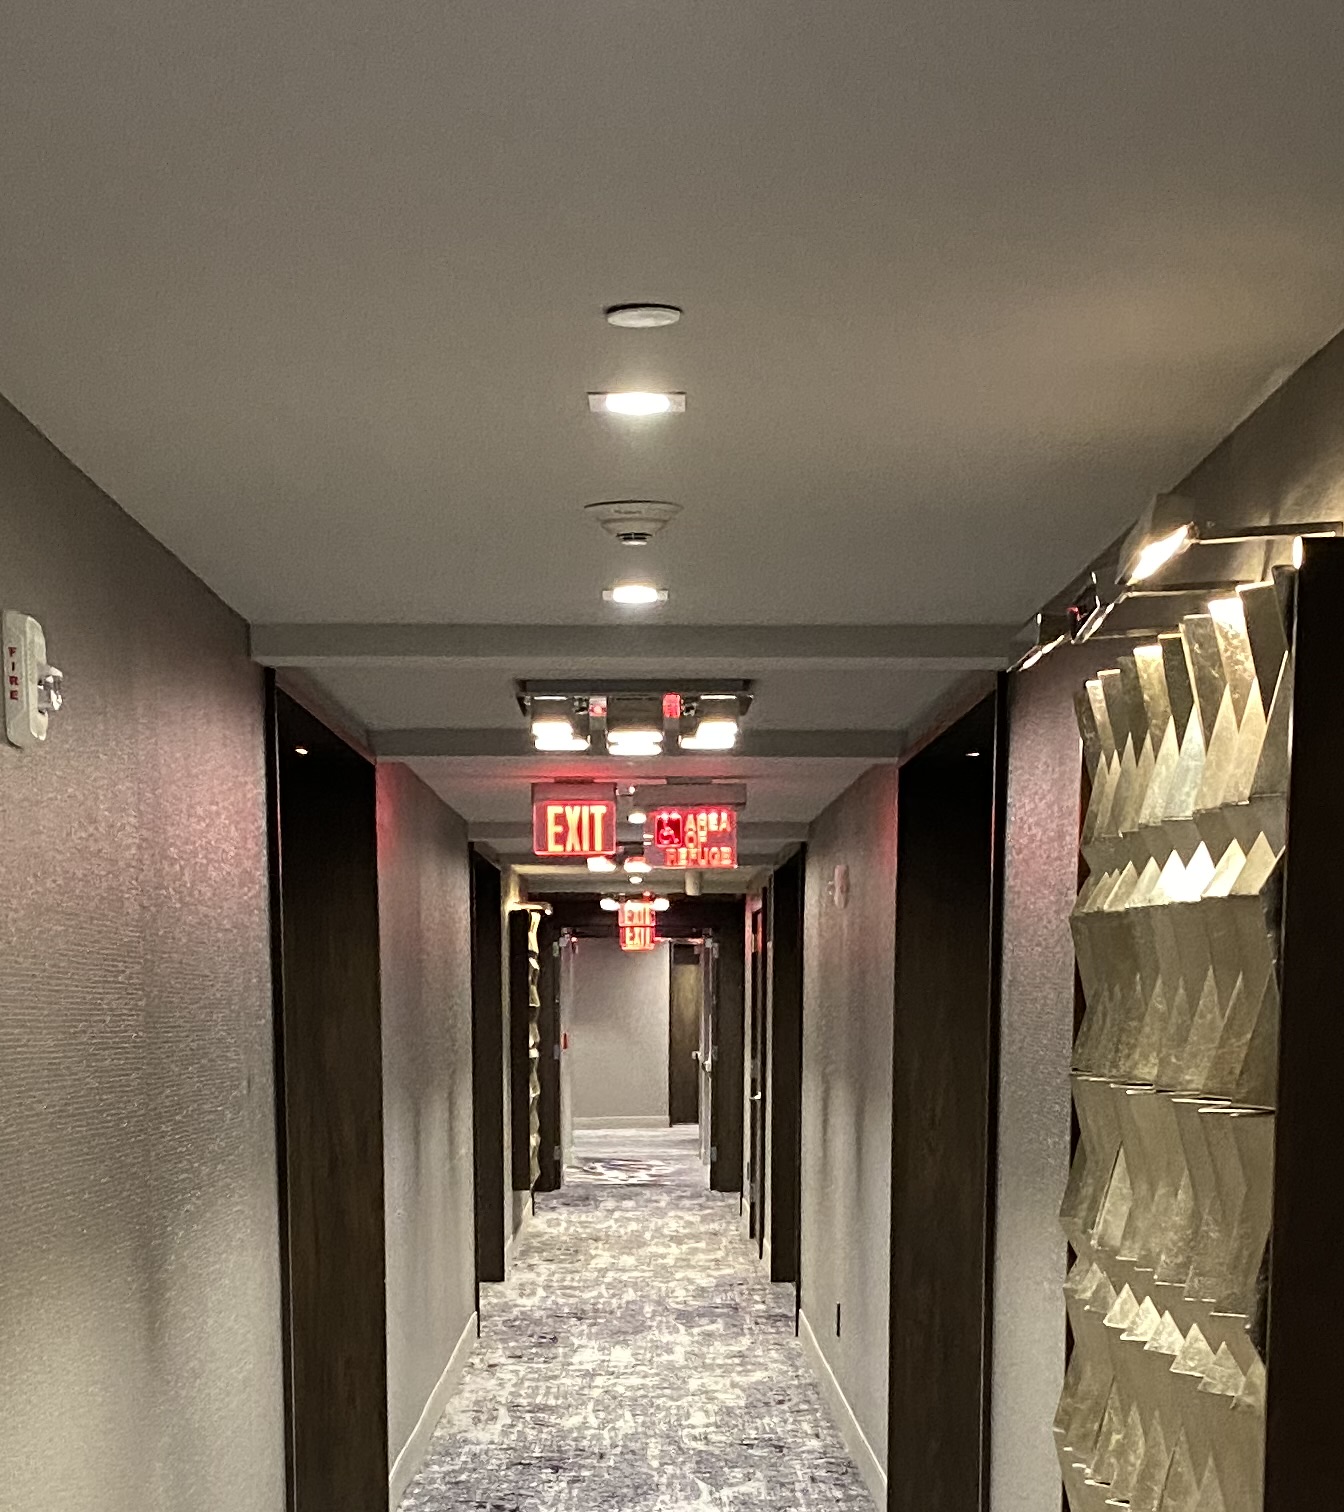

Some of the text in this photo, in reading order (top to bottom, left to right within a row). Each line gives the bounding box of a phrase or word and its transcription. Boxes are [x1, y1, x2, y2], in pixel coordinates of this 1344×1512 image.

[8, 646, 19, 701] FIRE
[547, 805, 607, 852] EXIT
[684, 811, 732, 832] AREA
[684, 830, 708, 849] OF
[665, 846, 733, 866] REFUGE
